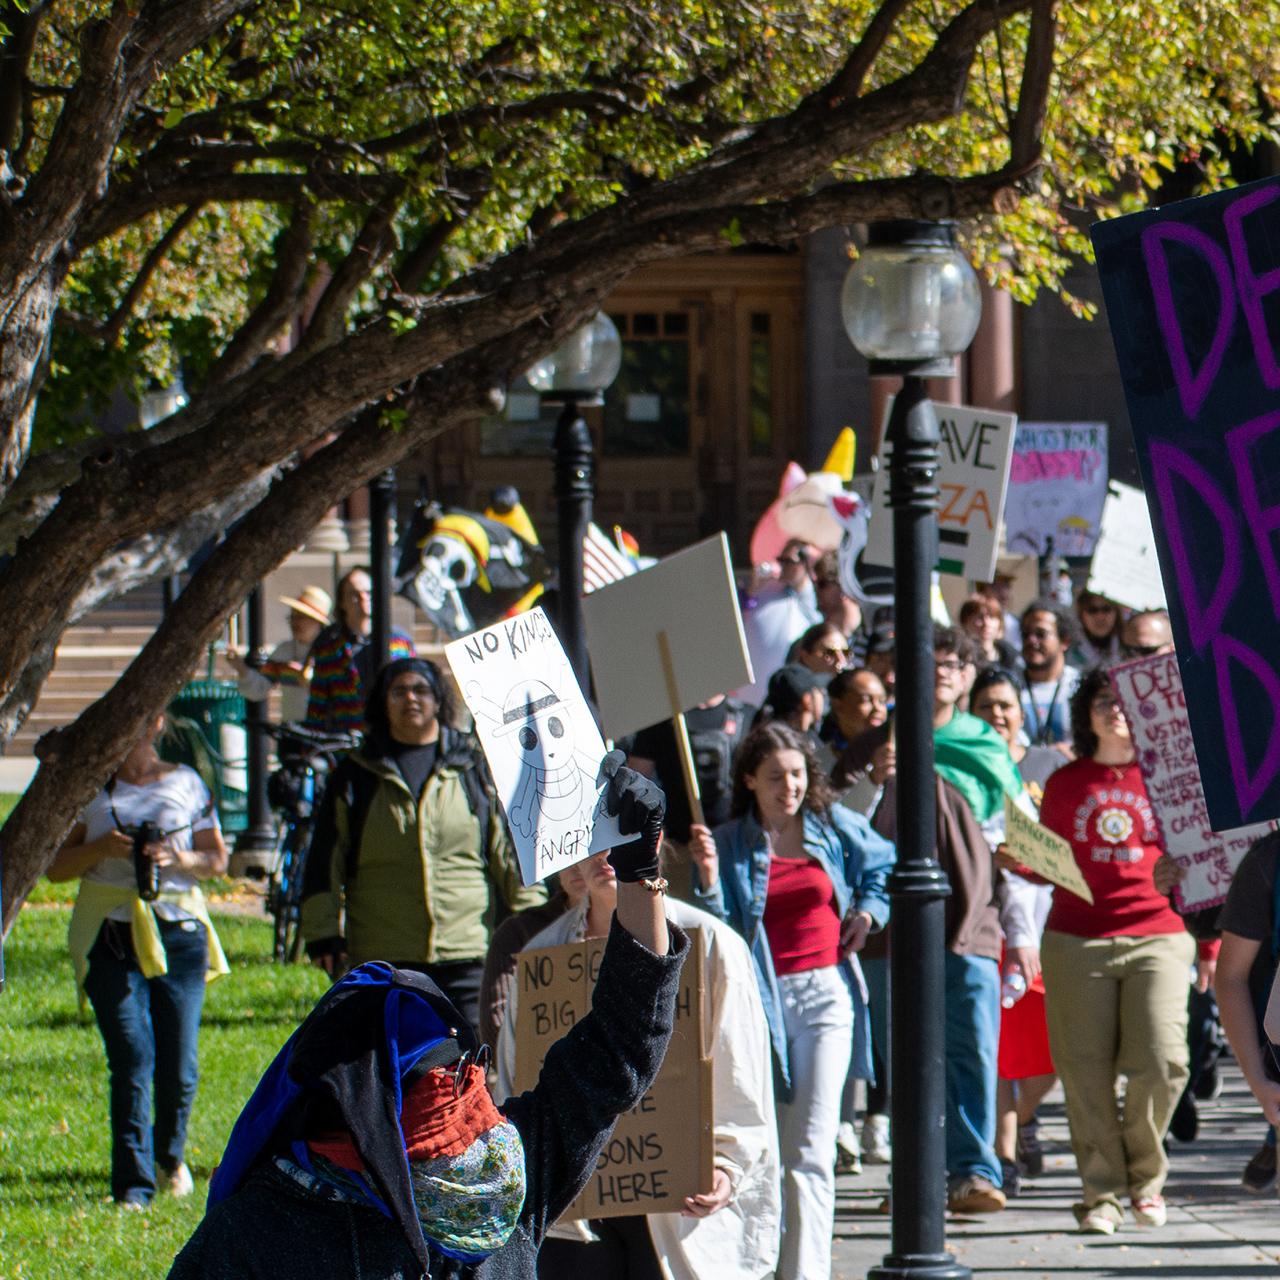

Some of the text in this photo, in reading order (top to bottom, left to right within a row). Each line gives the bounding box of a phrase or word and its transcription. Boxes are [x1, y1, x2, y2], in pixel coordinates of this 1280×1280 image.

[940, 418, 999, 470] AVE
[935, 482, 993, 530] ZA
[464, 631, 499, 663] NO
[1130, 660, 1181, 701] DEA
[540, 822, 596, 870] ANGRY
[524, 955, 554, 991] NO
[532, 1000, 576, 1035] BIG
[596, 1133, 663, 1169] SONS
[597, 1170, 669, 1206] HERE
